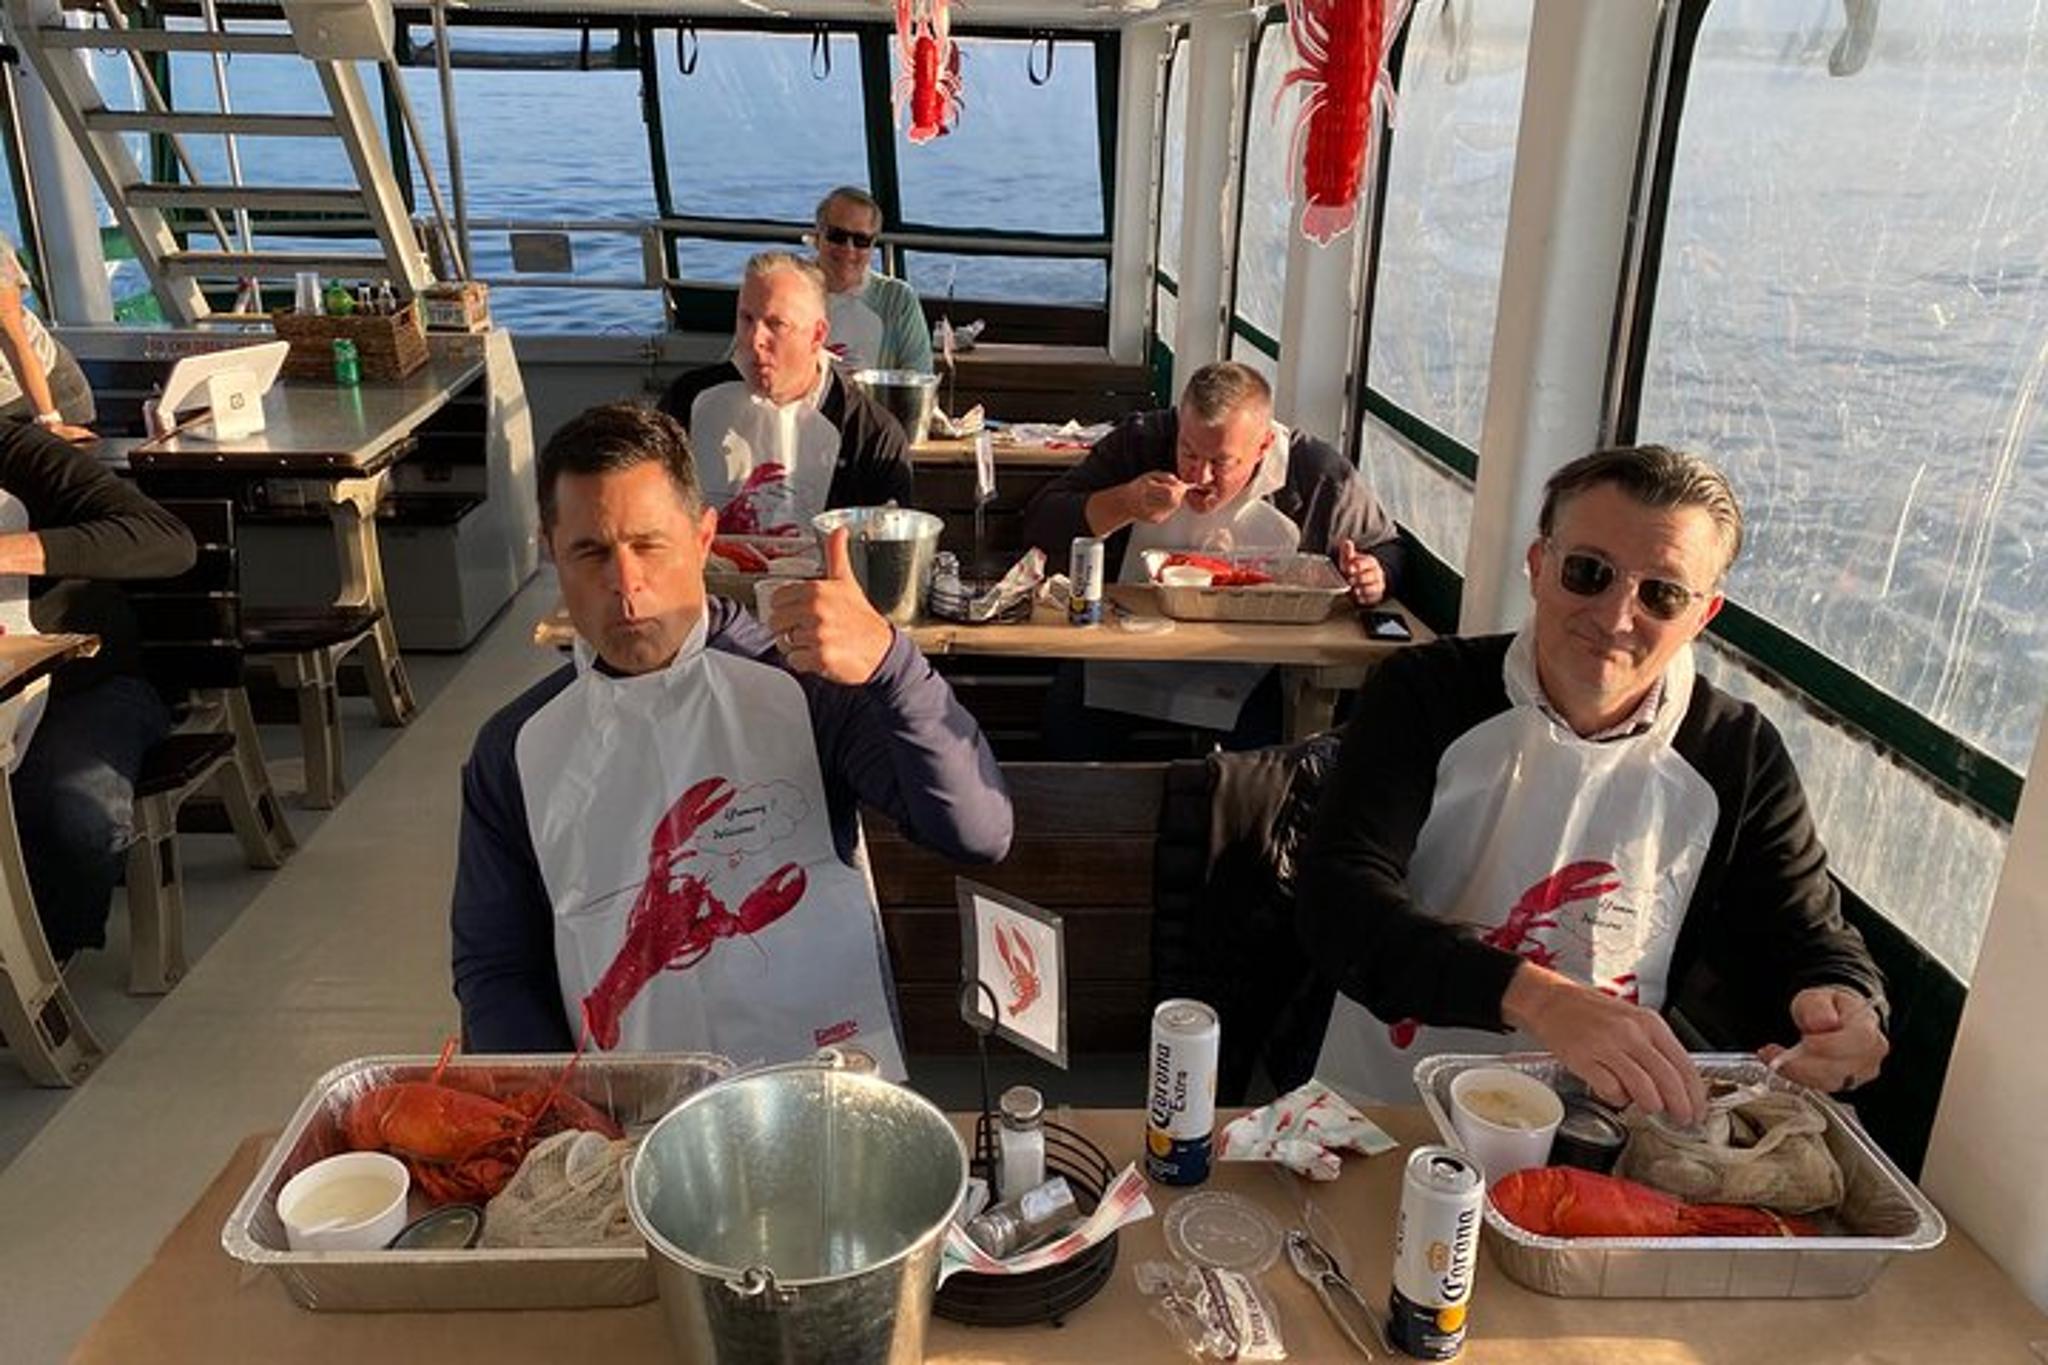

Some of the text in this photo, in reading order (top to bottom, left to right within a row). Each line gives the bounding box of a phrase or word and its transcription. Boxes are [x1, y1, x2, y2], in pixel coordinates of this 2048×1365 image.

[1151, 1042, 1171, 1129] Corona
[1169, 1071, 1187, 1112] Extra
[1440, 1209, 1477, 1301] Corona
